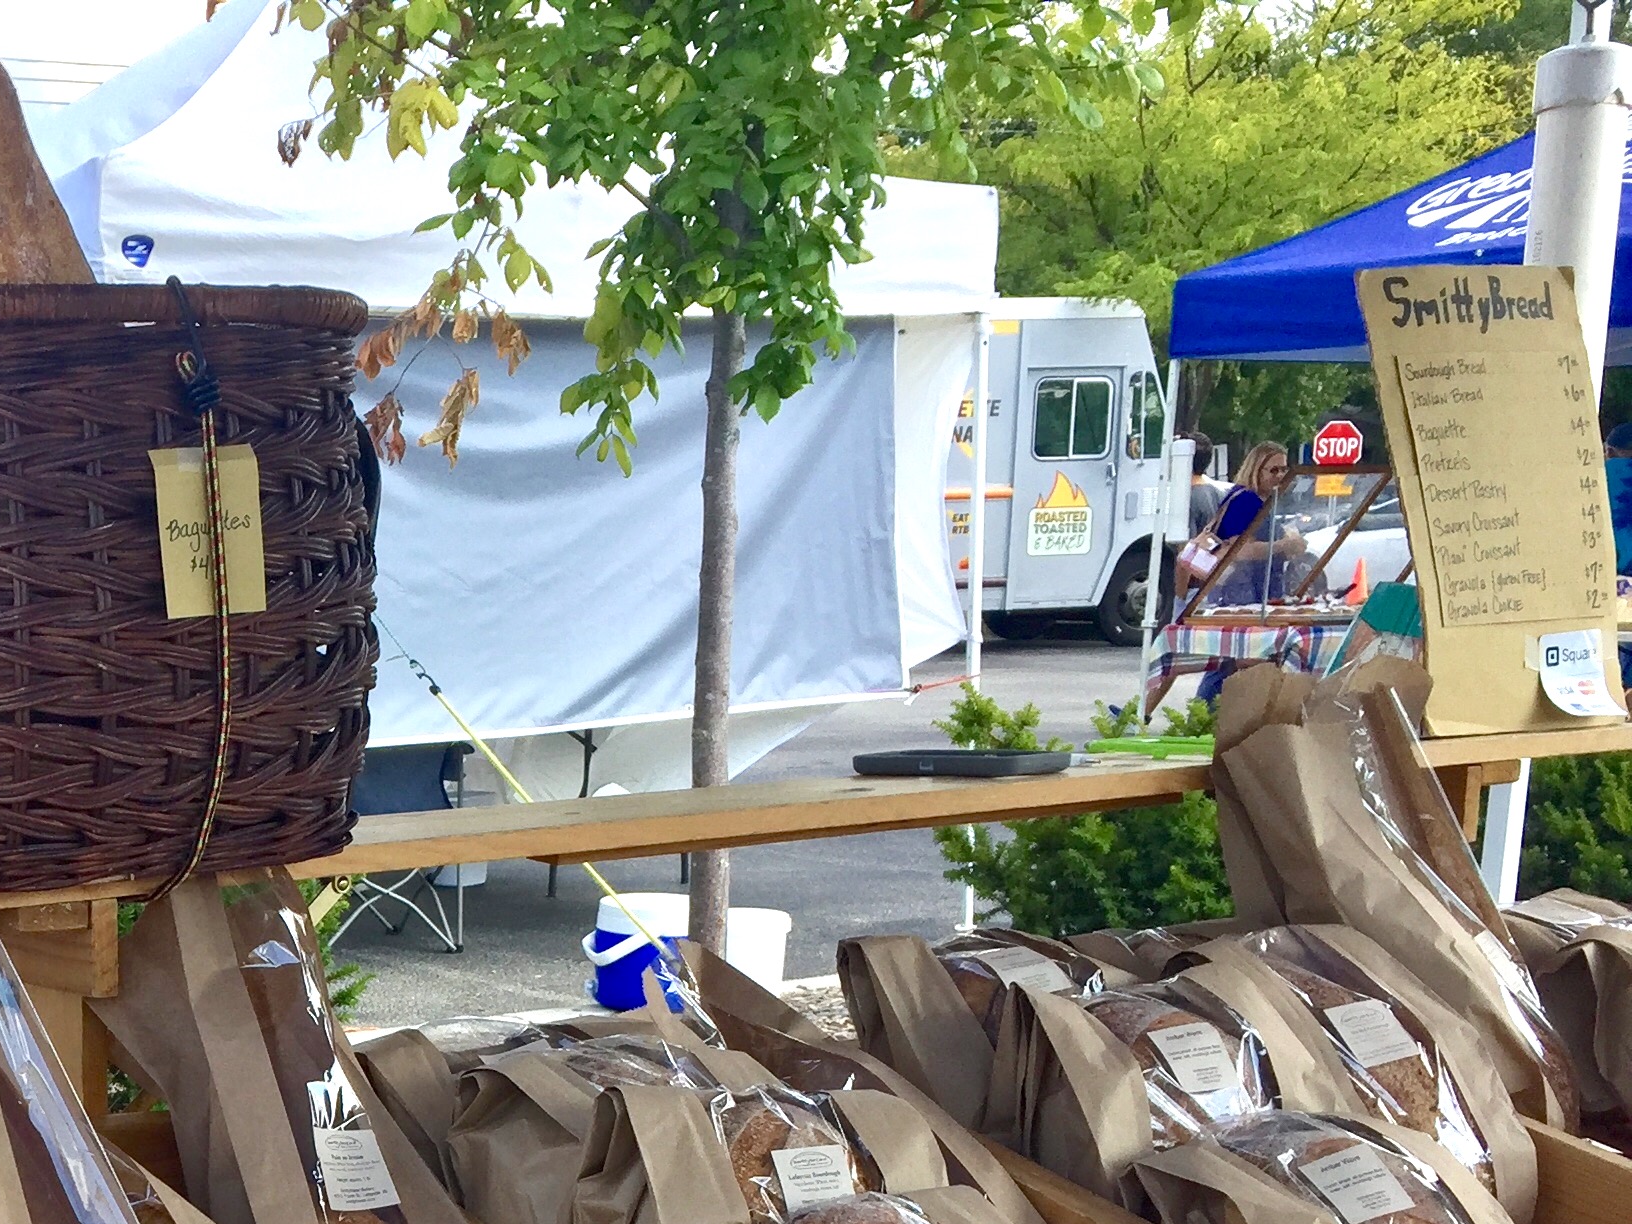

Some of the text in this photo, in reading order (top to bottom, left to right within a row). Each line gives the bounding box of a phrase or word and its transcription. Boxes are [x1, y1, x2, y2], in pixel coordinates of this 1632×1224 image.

[1382, 275, 1554, 334] SmittyBread
[1317, 437, 1359, 457] STOP
[1034, 510, 1087, 523] ROASTED
[1033, 523, 1087, 534] TOASTED
